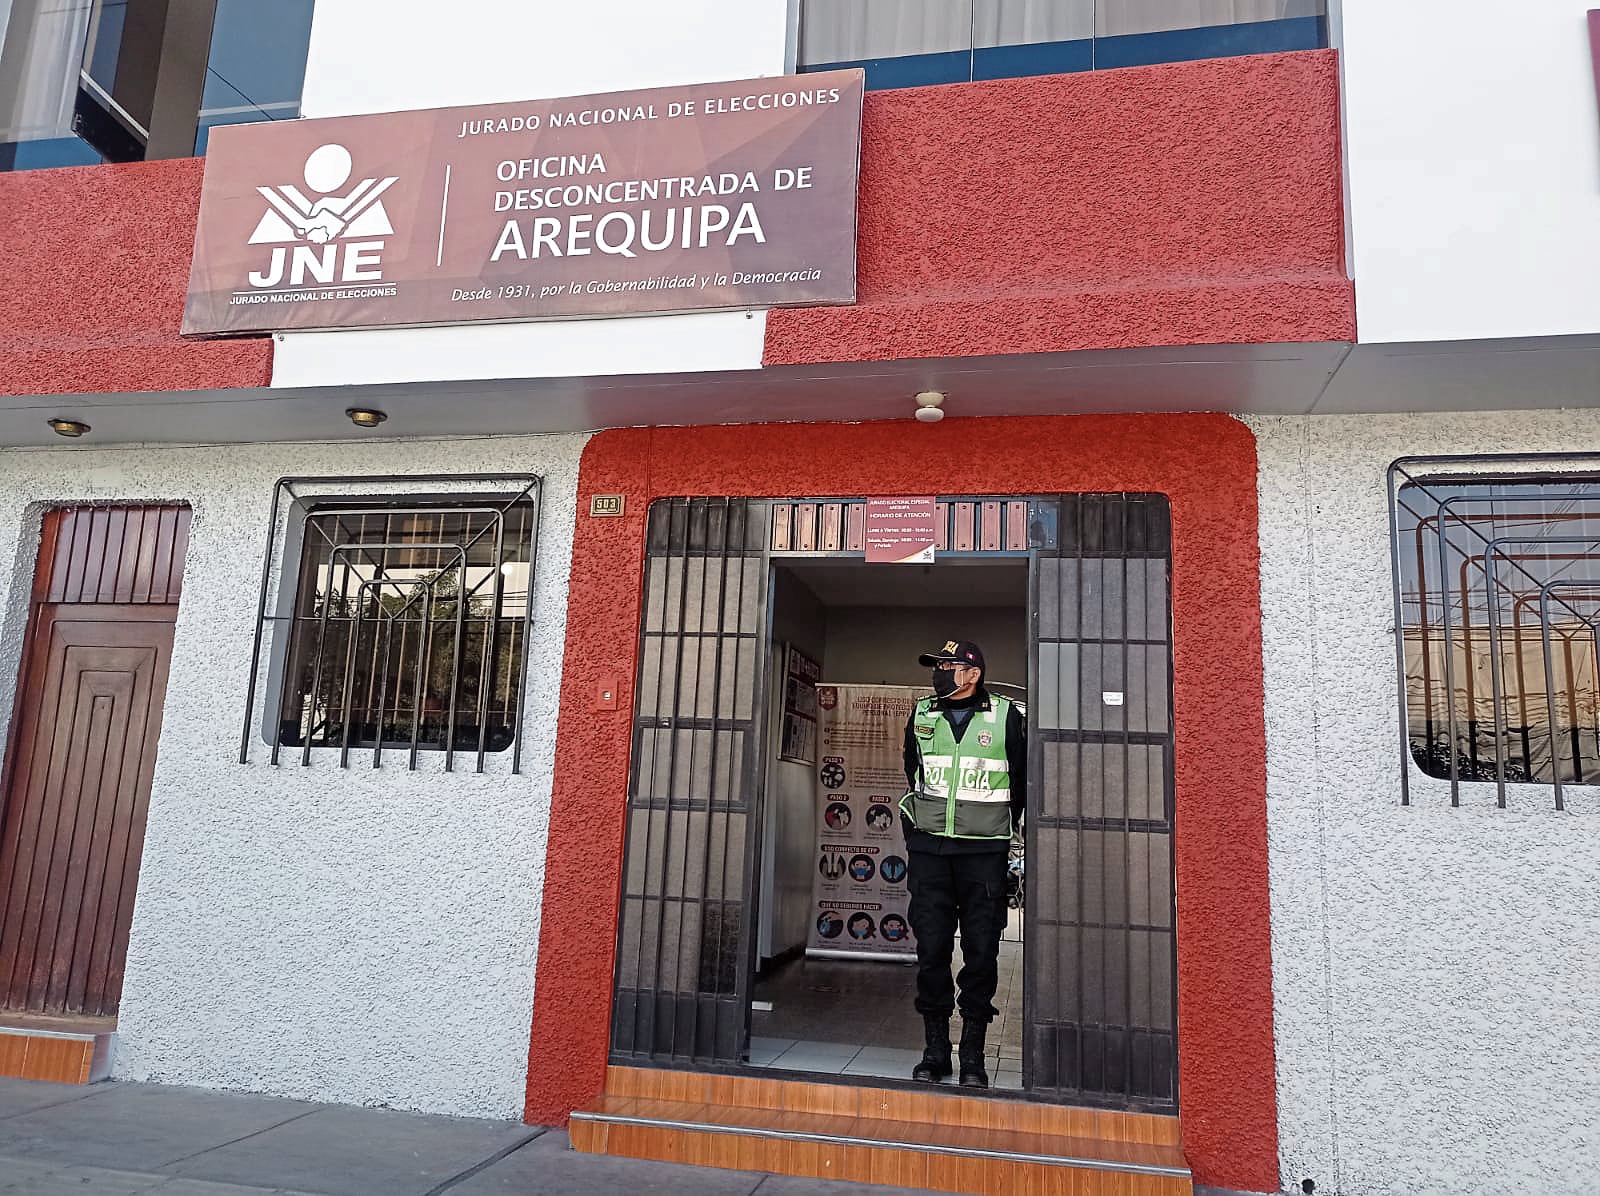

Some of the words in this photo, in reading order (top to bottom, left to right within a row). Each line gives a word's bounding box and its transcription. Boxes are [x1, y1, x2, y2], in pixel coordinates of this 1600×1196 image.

[458, 115, 541, 138] JURADO
[549, 104, 659, 129] NACIONAL
[668, 100, 696, 118] DE
[705, 88, 841, 115] ELECCIONES
[496, 153, 607, 181] OFICINA
[494, 171, 761, 213] DESCONCENTRADA
[774, 166, 813, 191] DE
[490, 202, 767, 262] AREQUIPA
[248, 240, 385, 288] JNE
[451, 287, 492, 302] Desde
[497, 285, 535, 300] 1931,
[540, 284, 565, 298] por
[569, 281, 582, 295] la
[586, 273, 696, 294] Gobernabilidad
[700, 276, 710, 289] y
[713, 272, 727, 286] la
[731, 267, 822, 285] Democracia
[230, 294, 269, 305] JURADO
[270, 292, 319, 303] NACIONAL
[320, 291, 334, 300] DE
[336, 287, 397, 299] ELECCIONES
[596, 498, 616, 509] 503
